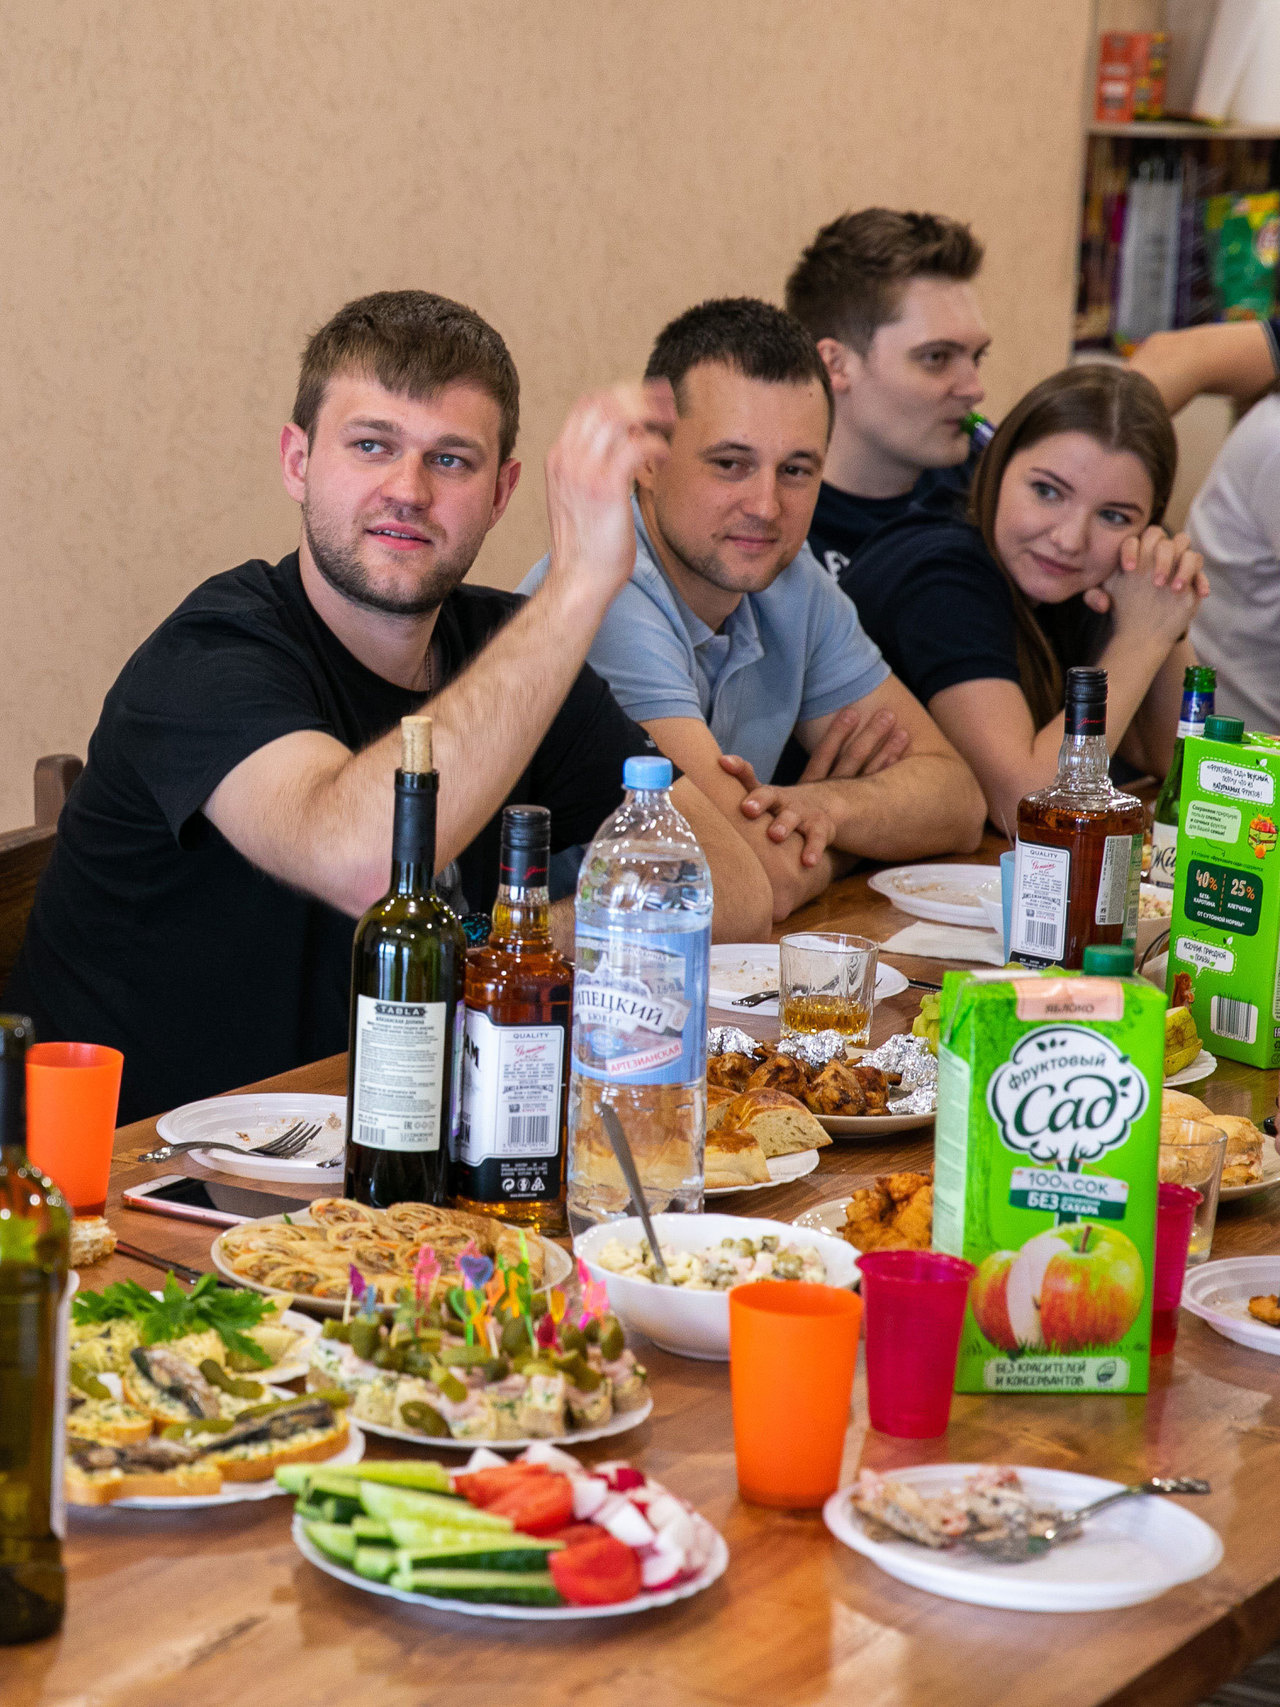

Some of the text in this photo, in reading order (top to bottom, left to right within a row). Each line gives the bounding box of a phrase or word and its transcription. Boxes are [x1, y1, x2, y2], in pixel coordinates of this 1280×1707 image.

[1029, 849, 1058, 859] QUALITY
[1195, 869, 1218, 891] 40%
[1231, 878, 1255, 900] 25%
[380, 1005, 420, 1016] TABLA
[1045, 1002, 1095, 1014] ЯБЛОКО
[1008, 1052, 1107, 1091] фруктовый
[1014, 1074, 1118, 1137] Сад
[1073, 1179, 1108, 1196] СОК
[1027, 1191, 1060, 1210] БЕЗ
[1060, 1203, 1099, 1216] САХАРА
[995, 1361, 1086, 1374] БЕЗ КРАСИТЕЛЕЙ
[995, 1375, 1084, 1386] И КОНСЕРВАНТОВ
